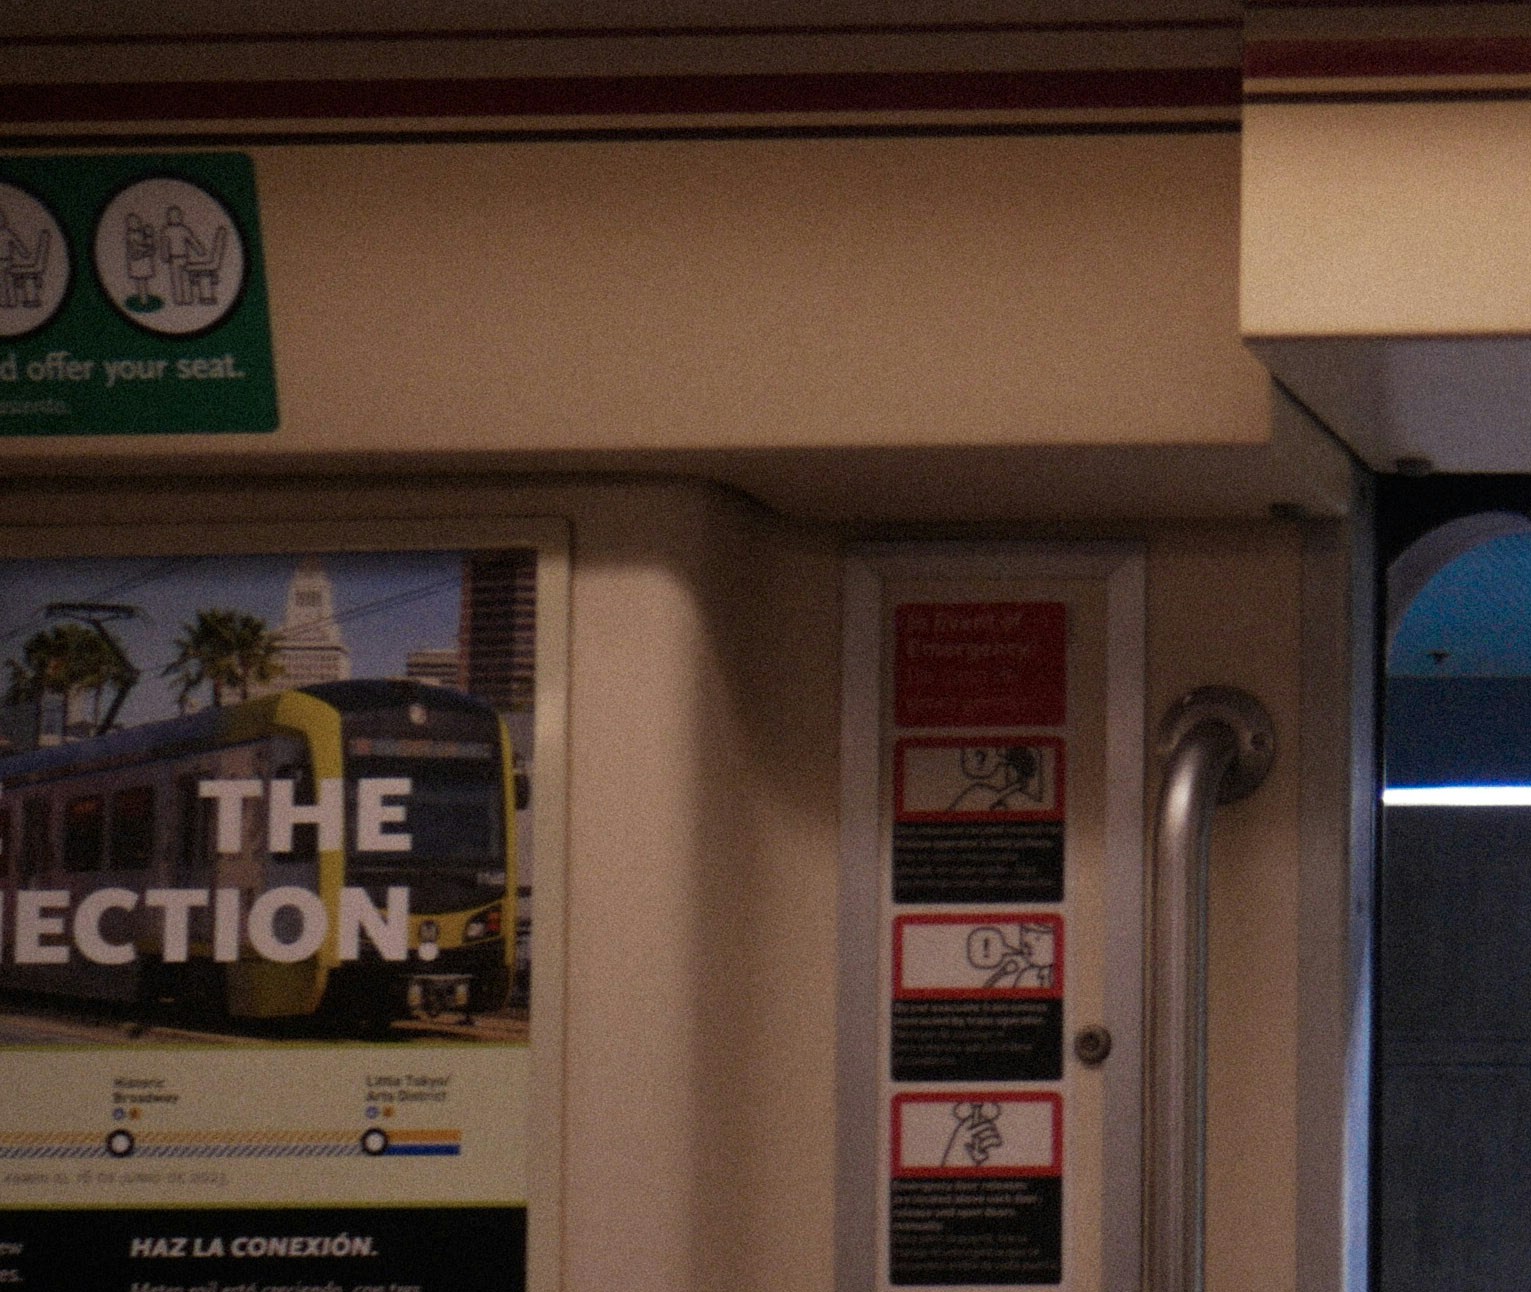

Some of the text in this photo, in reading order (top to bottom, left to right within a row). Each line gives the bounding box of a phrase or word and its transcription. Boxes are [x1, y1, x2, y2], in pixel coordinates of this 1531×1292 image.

[26, 351, 95, 381] offer
[103, 359, 168, 388] your
[176, 353, 246, 379] seat.
[199, 777, 413, 853] THE
[0, 885, 441, 966] ECTION.
[129, 1231, 380, 1258] HAZ LA CONEXIÓN.
